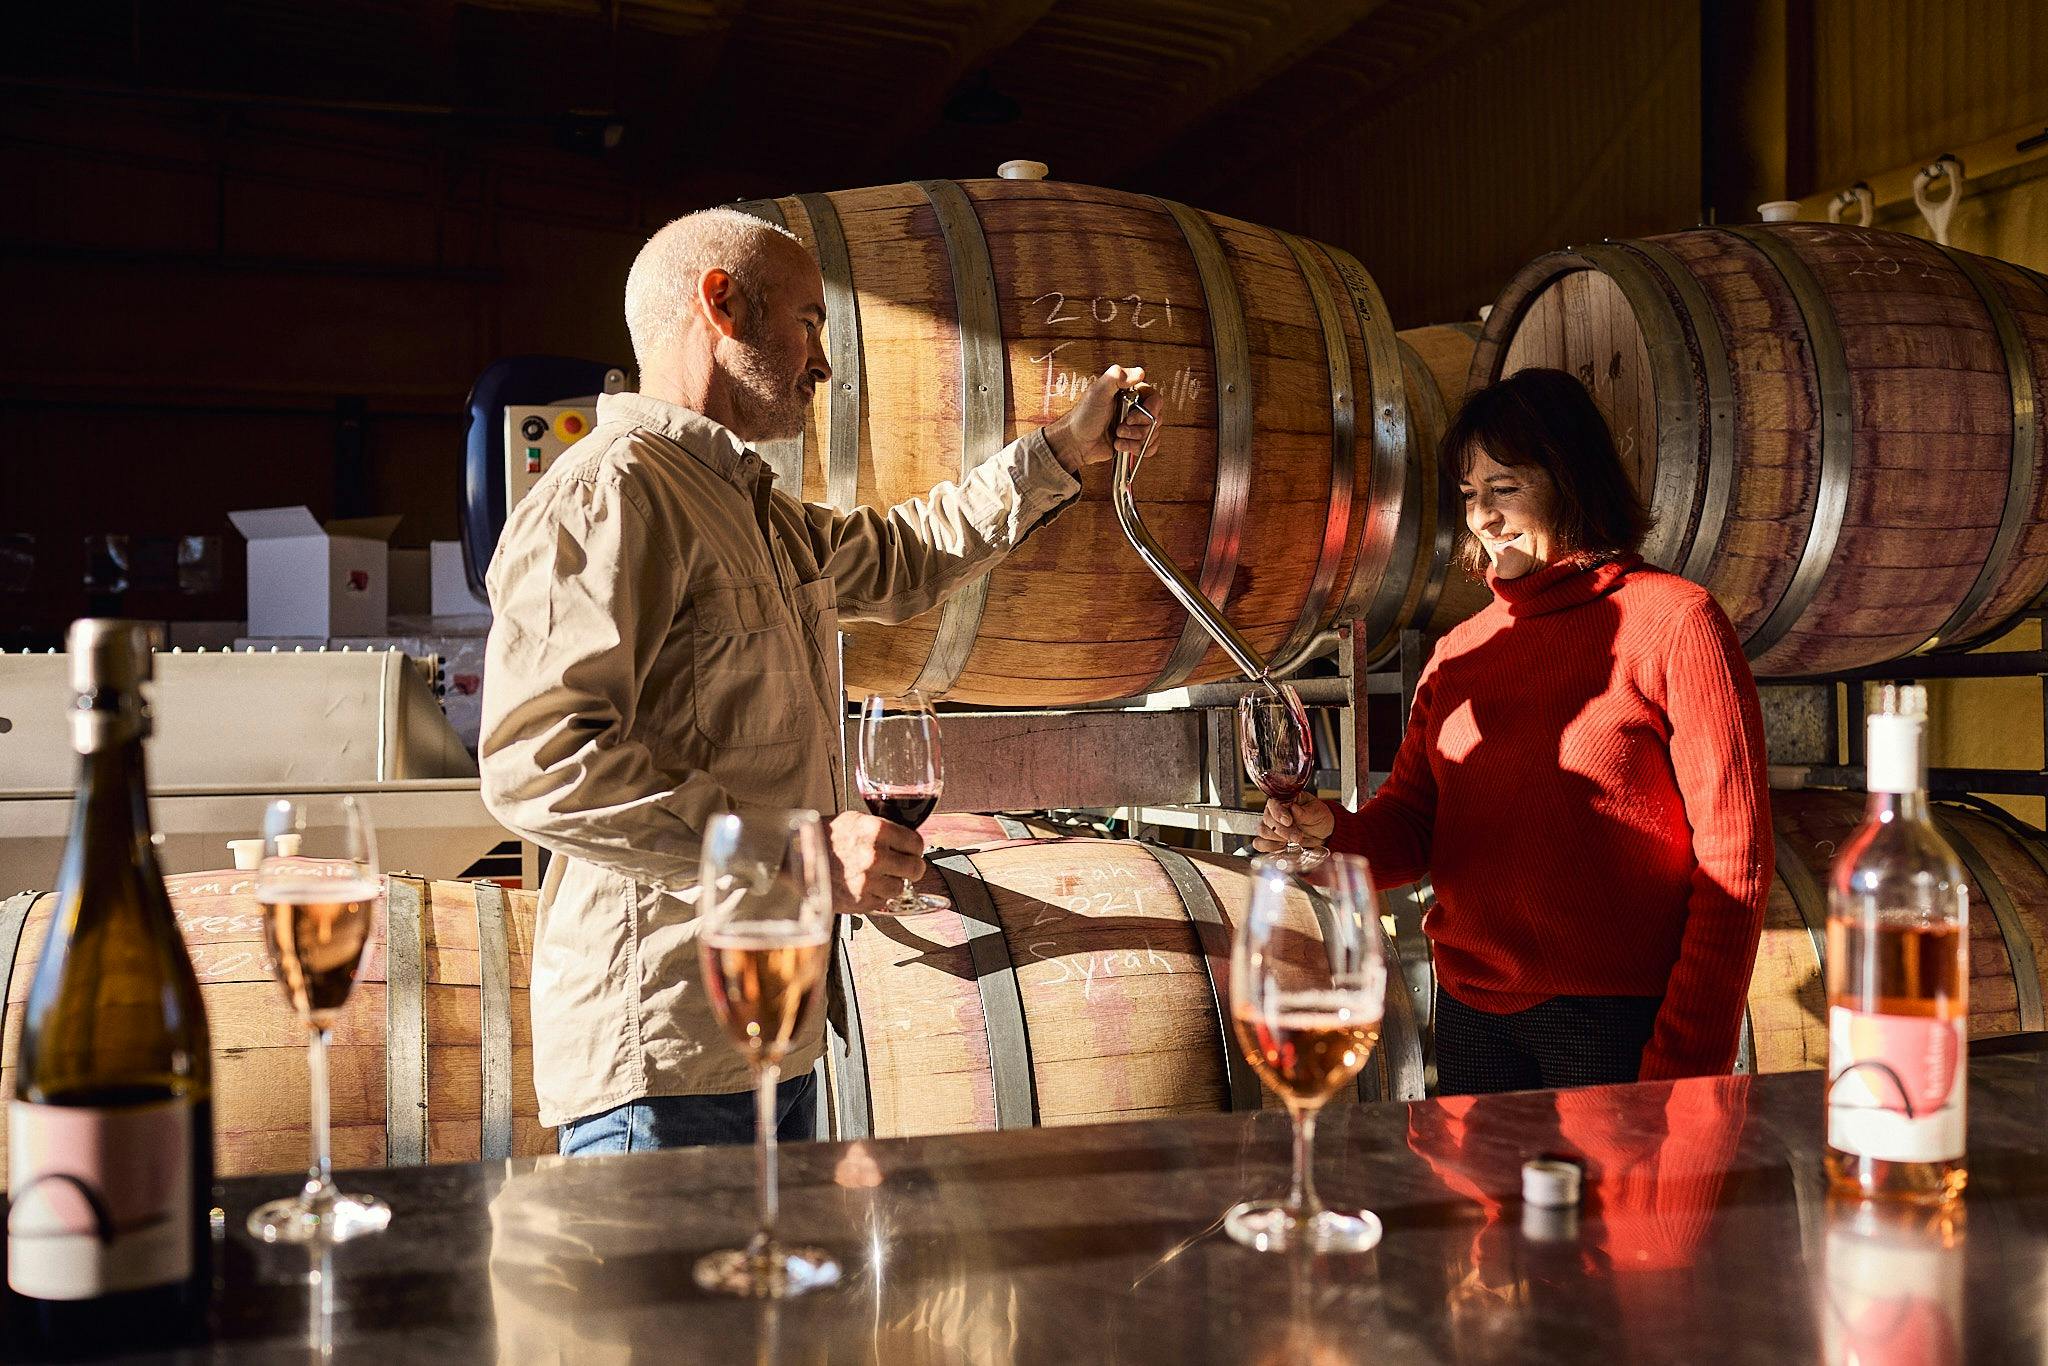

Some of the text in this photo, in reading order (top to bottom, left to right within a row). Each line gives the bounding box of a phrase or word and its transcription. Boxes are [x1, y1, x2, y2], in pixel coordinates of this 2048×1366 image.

[1031, 291, 1174, 329] 2021
[1024, 890, 1146, 927] 2021
[1028, 940, 1175, 1001] Syrah
